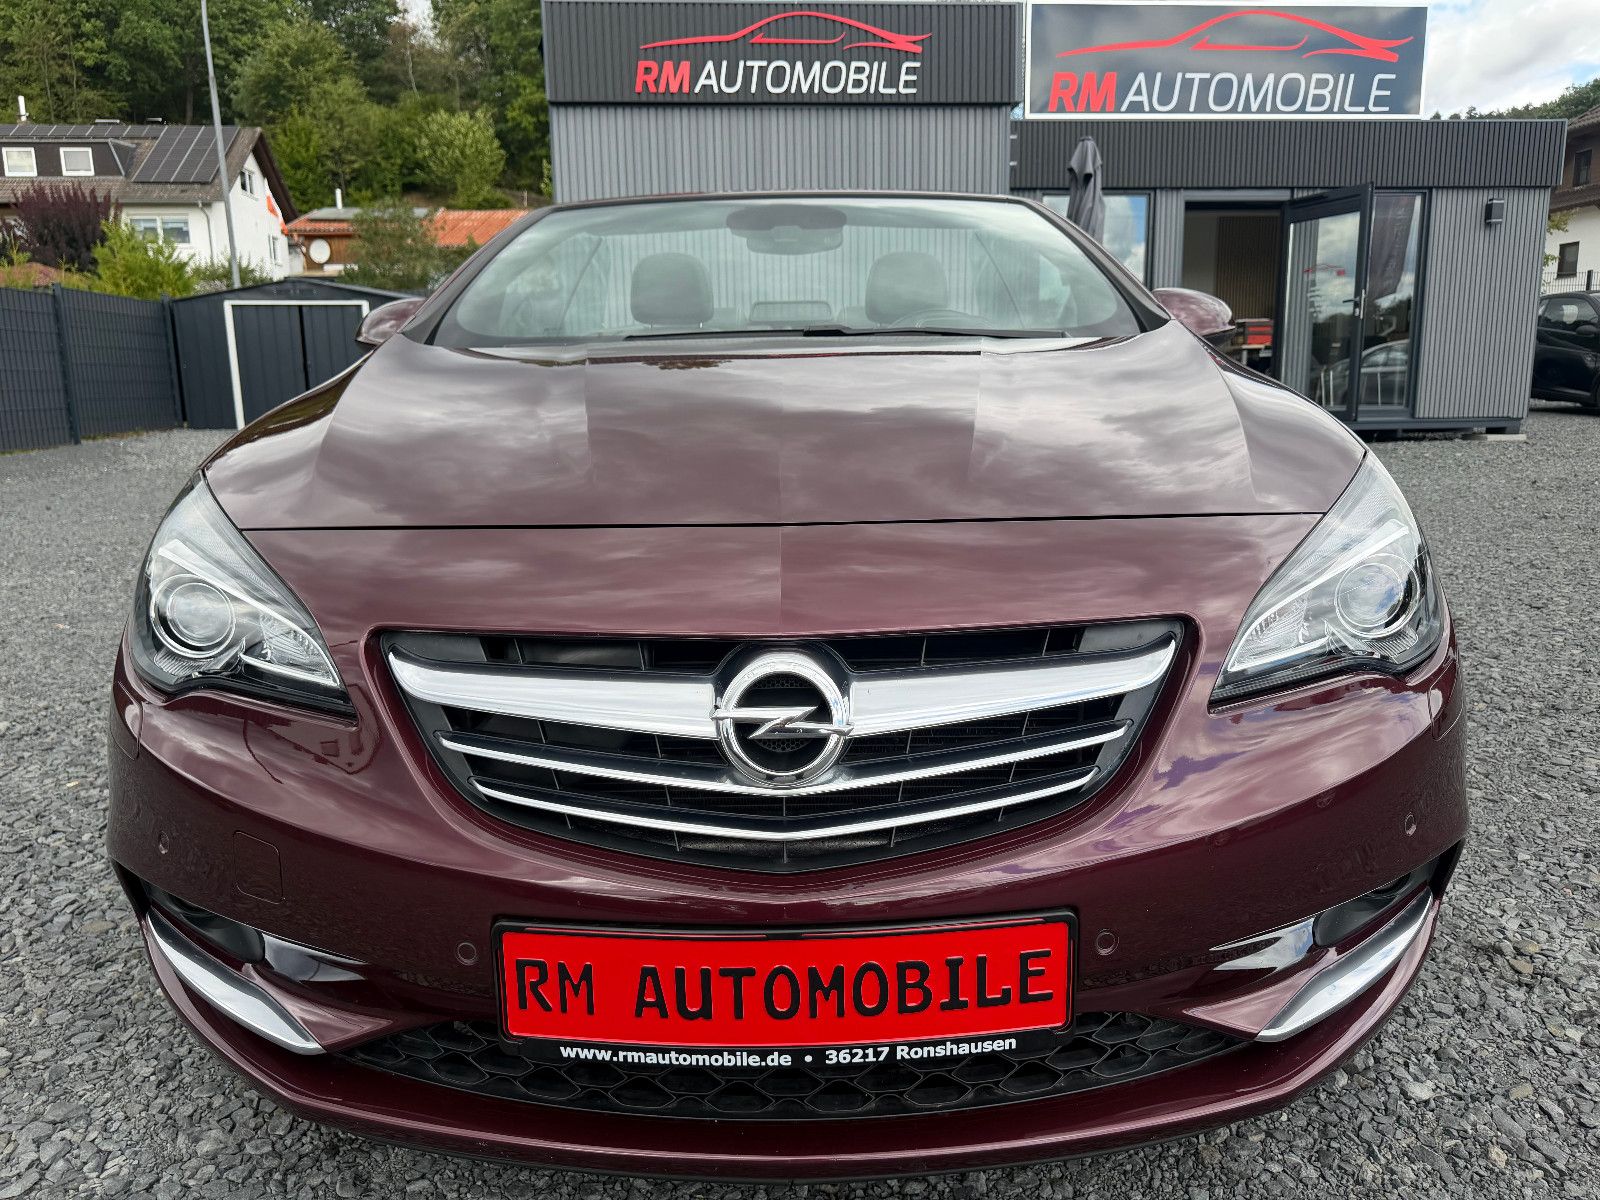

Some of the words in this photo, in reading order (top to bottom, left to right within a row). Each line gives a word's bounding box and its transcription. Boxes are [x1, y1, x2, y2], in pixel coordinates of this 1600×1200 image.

[634, 60, 691, 94] RM
[694, 60, 922, 94] AUTOMOBILE
[1047, 71, 1118, 112] RM
[1120, 71, 1397, 112] AUTOMOBILE
[515, 958, 595, 1016] RM
[634, 949, 1054, 1021] AUTOMOBILE
[559, 1046, 793, 1067] www.rmautomobile.de
[825, 1047, 890, 1065] 36217
[896, 1037, 1017, 1060] Ronshausen
